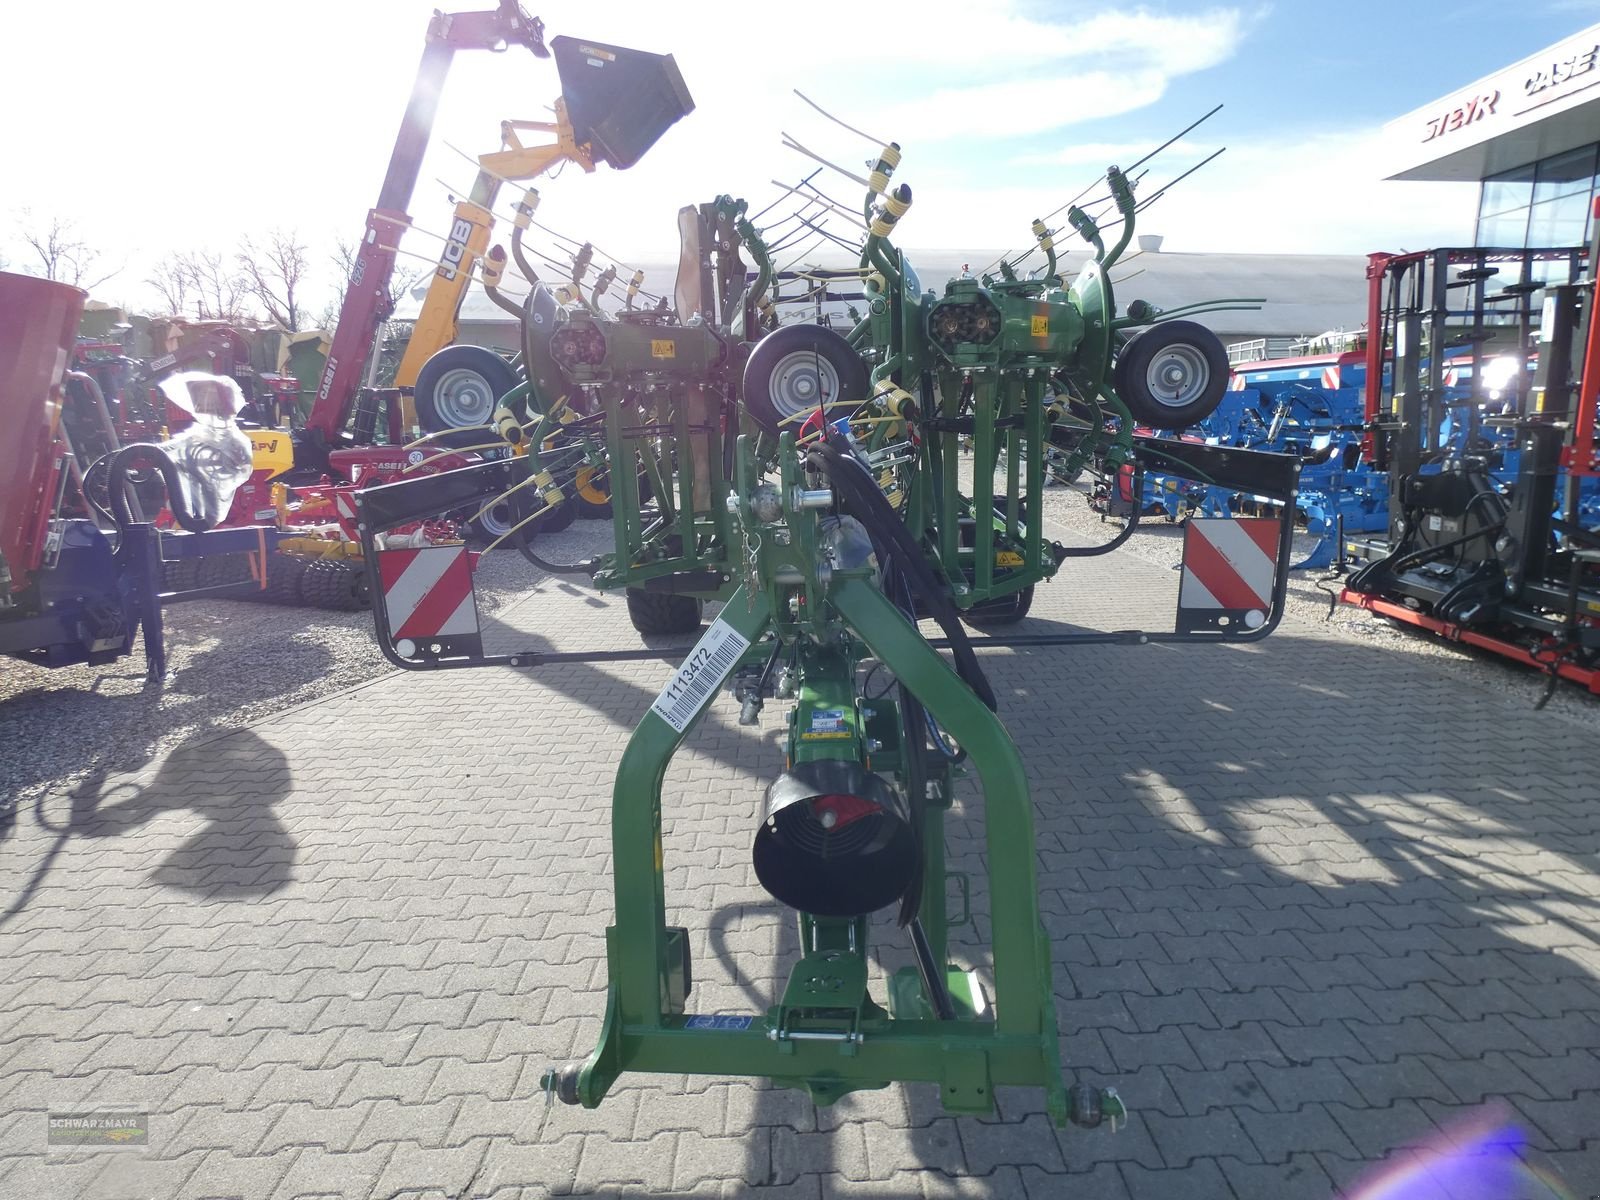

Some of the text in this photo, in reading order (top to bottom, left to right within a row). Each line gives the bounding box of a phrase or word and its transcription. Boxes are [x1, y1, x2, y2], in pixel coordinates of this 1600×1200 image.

[1421, 45, 1600, 143] STEYR CASE
[441, 219, 472, 280] JCB
[409, 453, 422, 463] 30
[667, 647, 712, 701] 1113472
[655, 704, 677, 726] KRONE
